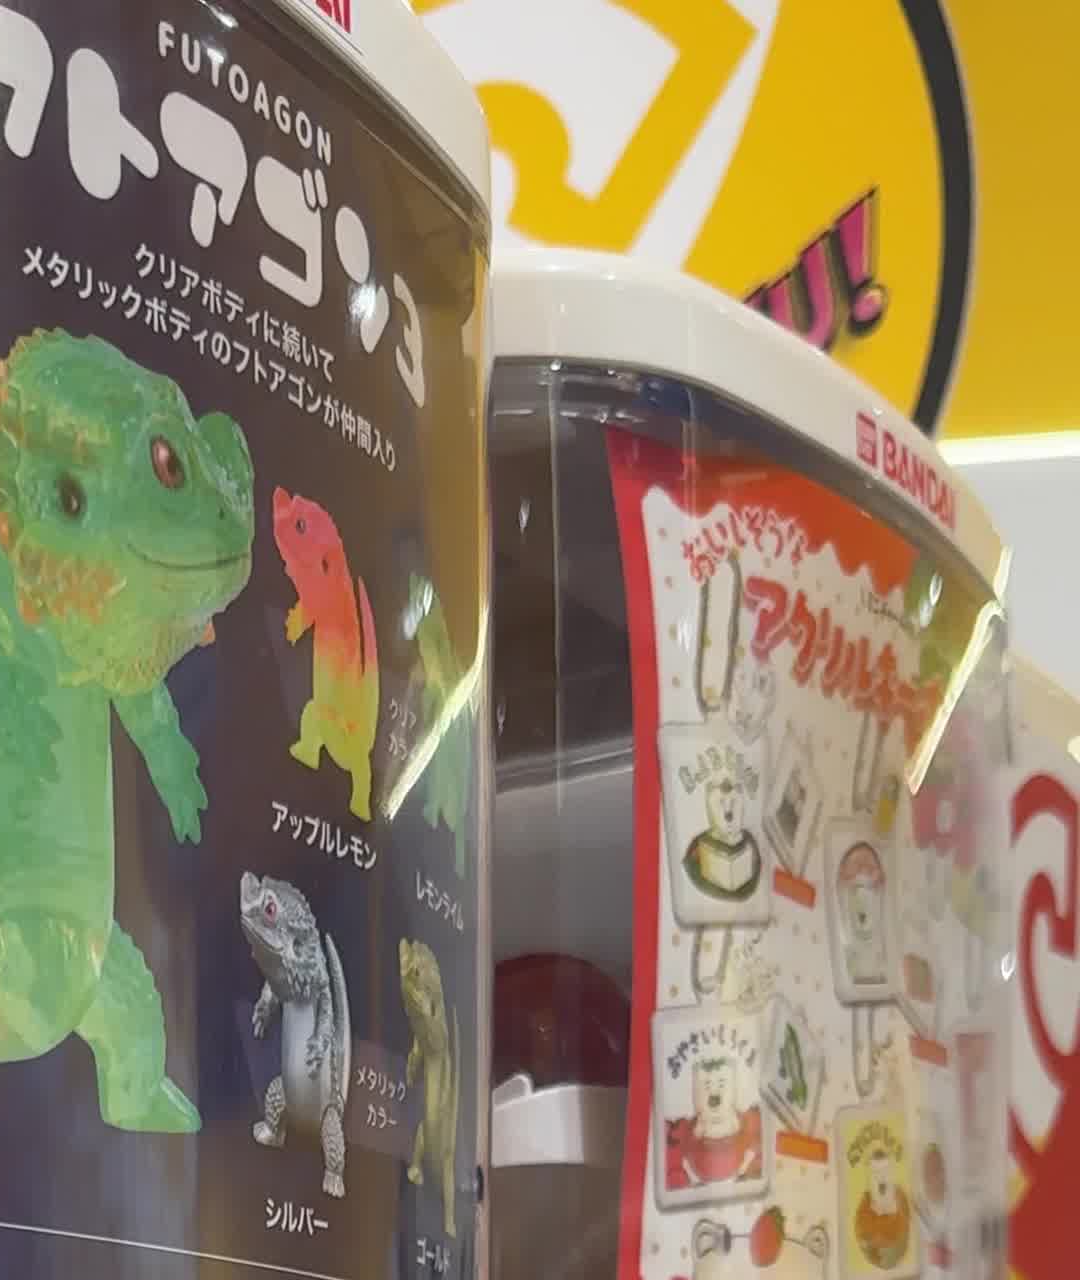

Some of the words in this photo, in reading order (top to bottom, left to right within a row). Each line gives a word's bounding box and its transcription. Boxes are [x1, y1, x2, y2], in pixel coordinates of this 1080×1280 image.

[159, 21, 333, 167] FUTOAGON
[134, 243, 335, 387] クリアボディに続いて
[22, 246, 398, 474] メタリックボディのフトアゴンが仲間入り
[882, 431, 957, 531] BANDAI
[270, 800, 378, 871] アップルレモン
[356, 1064, 407, 1103] メタリック
[366, 1103, 398, 1130] カラー
[265, 1197, 330, 1235] シルバー
